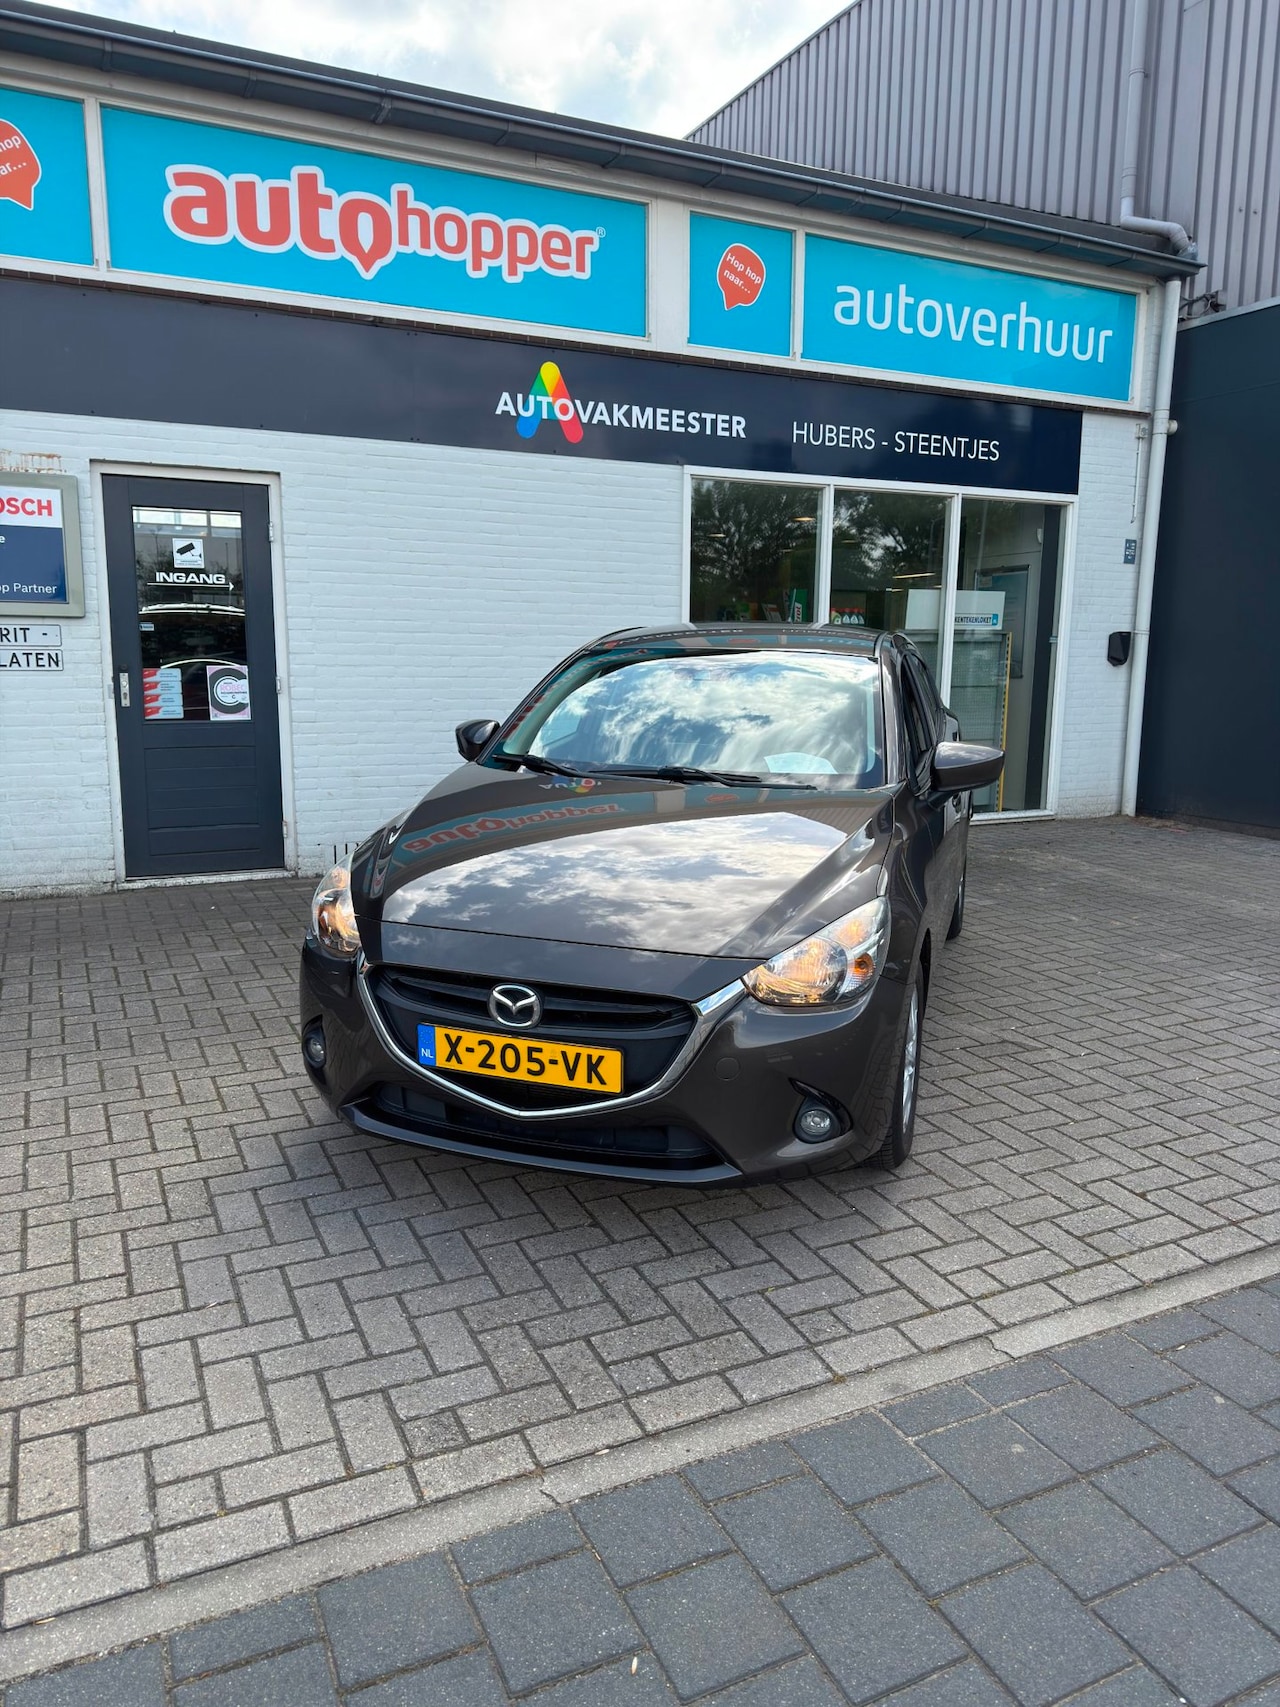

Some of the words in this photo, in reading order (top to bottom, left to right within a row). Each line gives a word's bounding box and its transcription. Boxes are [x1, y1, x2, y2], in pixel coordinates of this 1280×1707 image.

[726, 252, 745, 272] Hop
[745, 266, 762, 285] hop
[834, 283, 1113, 363] autoverhuur
[495, 391, 747, 439] AUTOVAKMEESTER
[792, 421, 876, 450] HUBERS
[894, 431, 1000, 461] STEENTJES
[13, 582, 57, 594] Partner
[155, 571, 226, 584] INGANG
[421, 1047, 434, 1059] NL
[444, 1033, 607, 1085] X-205-VK
